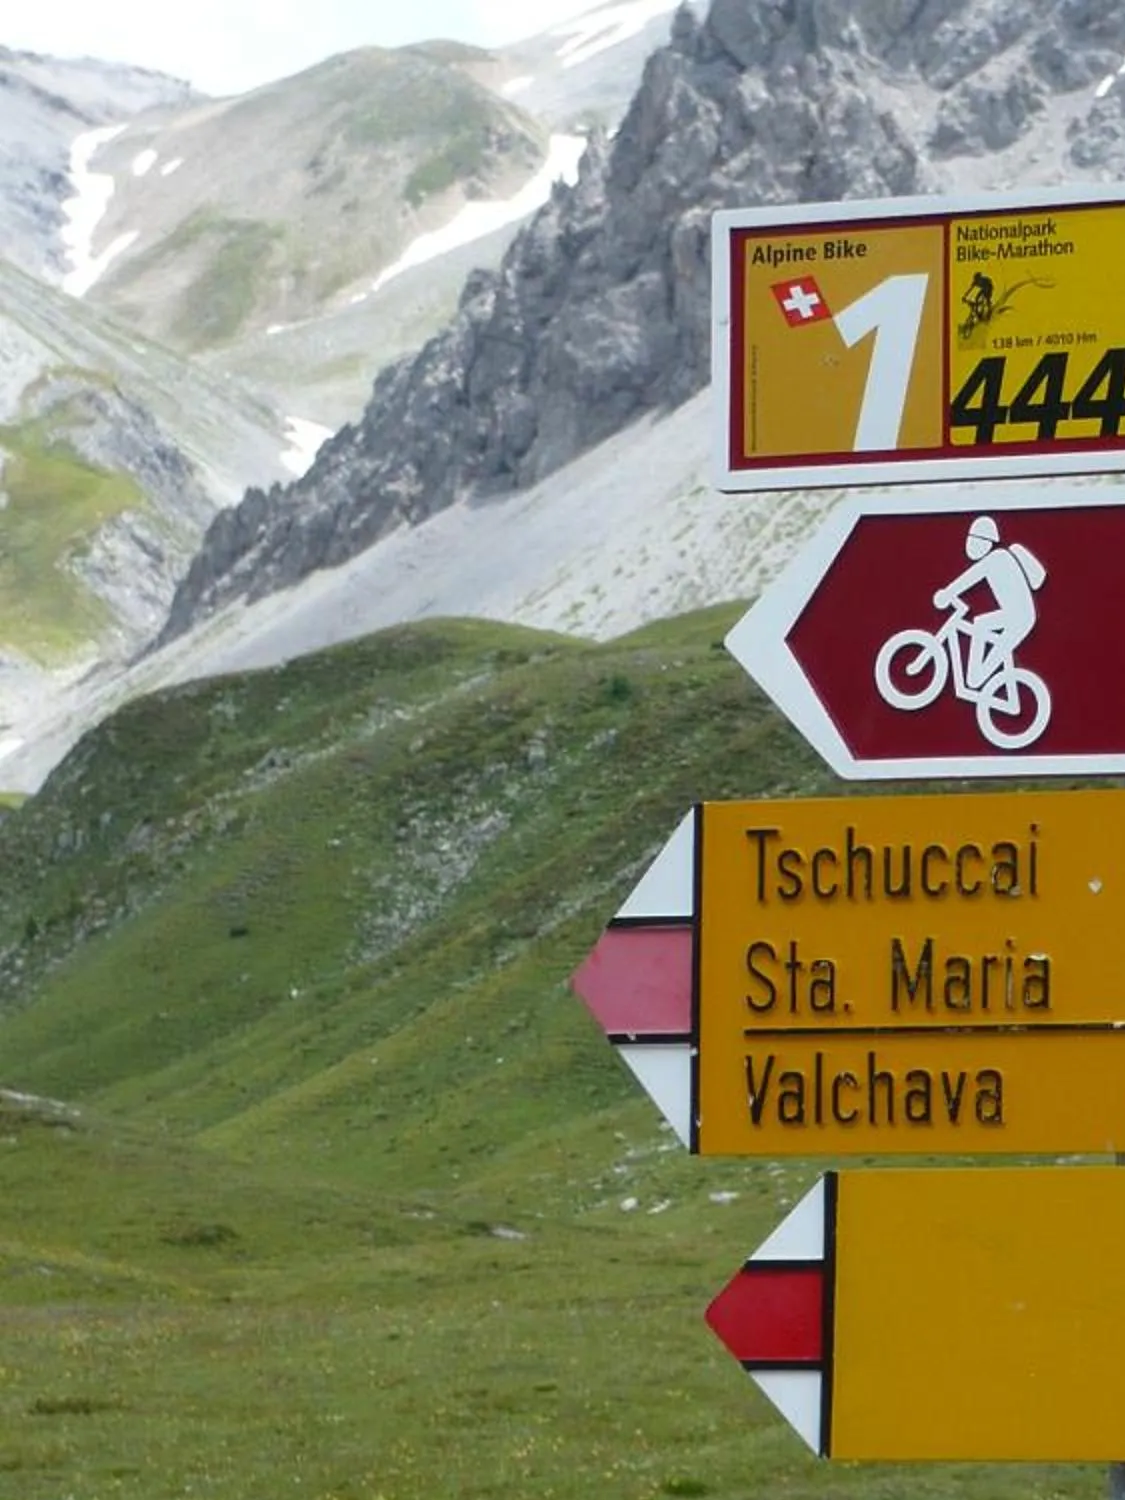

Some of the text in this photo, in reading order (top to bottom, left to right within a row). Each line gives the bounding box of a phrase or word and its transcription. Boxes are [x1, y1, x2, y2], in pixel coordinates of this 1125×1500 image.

[752, 240, 868, 267] Alpine Bike
[957, 217, 1057, 241] Nationalpark
[957, 238, 1074, 262] Bike-Marathon
[832, 272, 930, 452] 1
[746, 823, 1041, 901] Tschuccai
[745, 940, 853, 1013] Sta.
[891, 938, 1052, 1011] Maria
[744, 1052, 1005, 1126] Valchava
